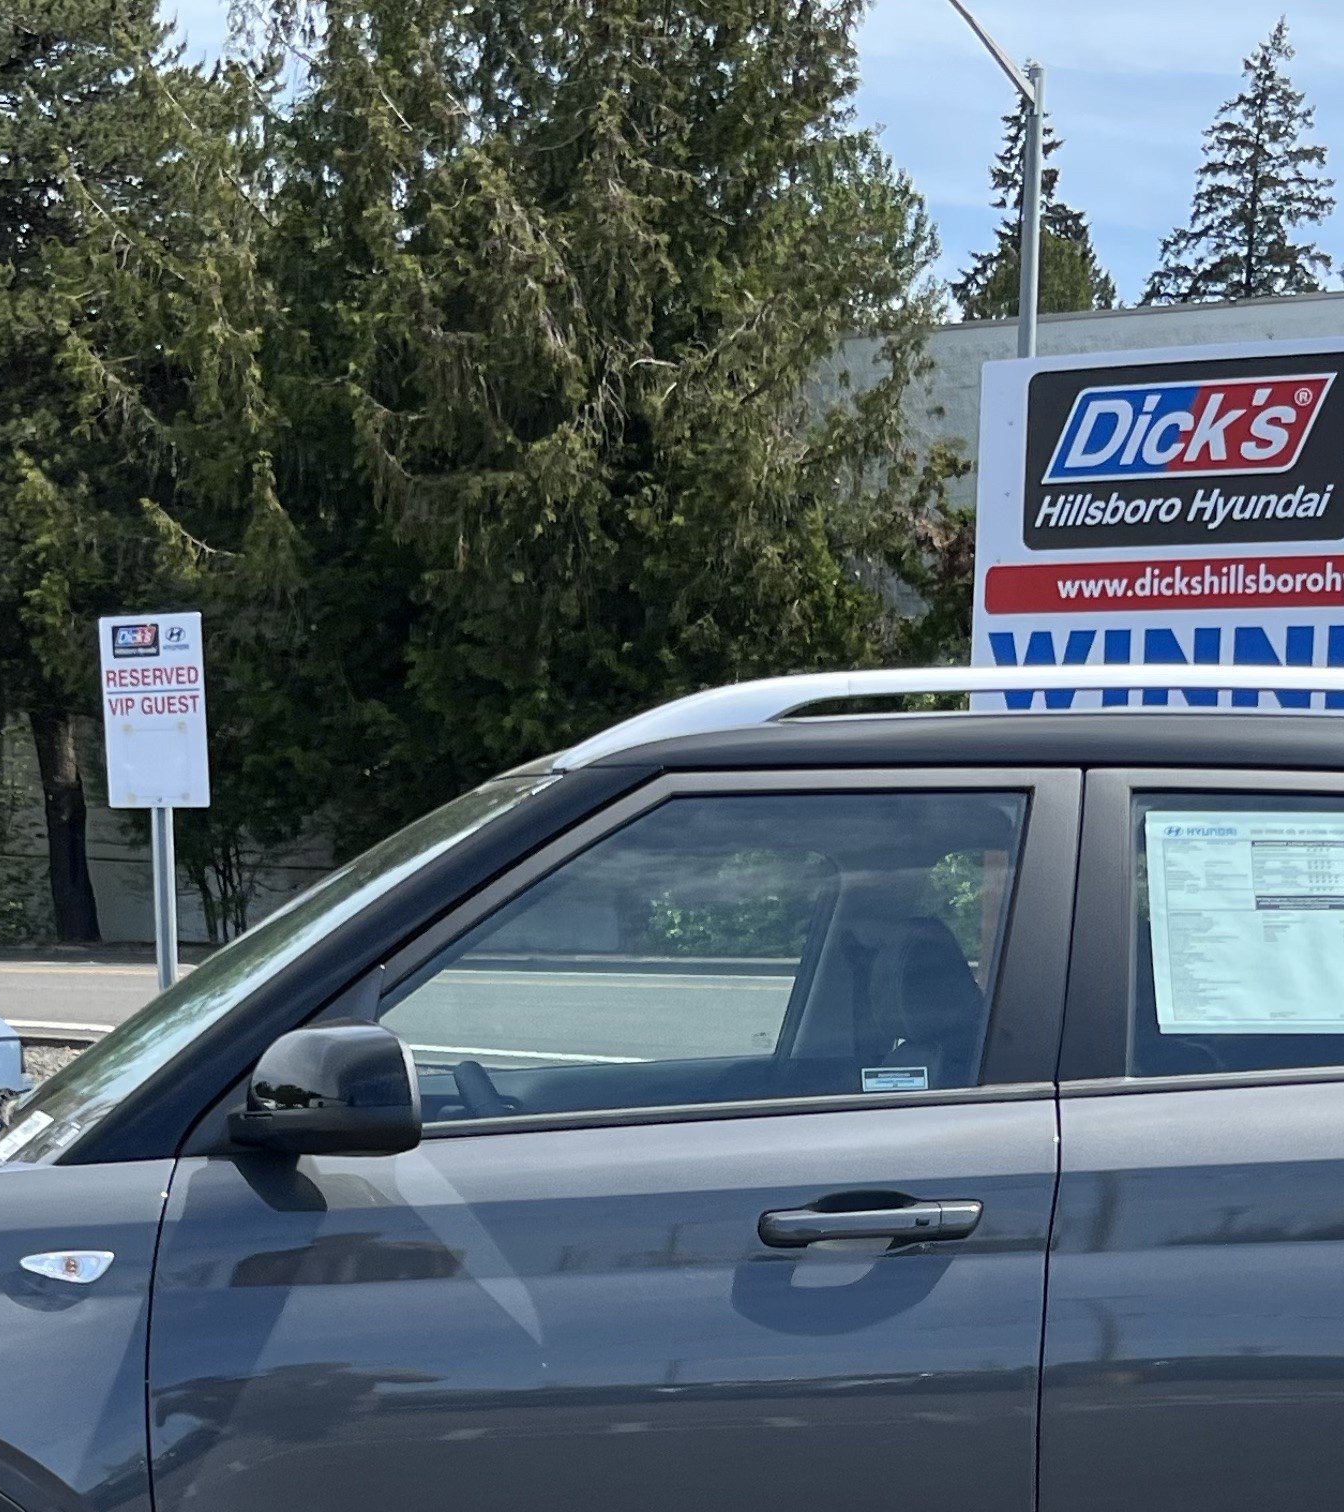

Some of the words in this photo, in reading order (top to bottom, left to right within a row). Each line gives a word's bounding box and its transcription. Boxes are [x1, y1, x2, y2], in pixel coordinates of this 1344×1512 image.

[1034, 492, 1182, 528] Hillsboro
[1186, 484, 1335, 530] Hyundai
[105, 666, 199, 688] RESERVED
[108, 698, 135, 716] VIP
[141, 694, 199, 715] GUEST
[1186, 827, 1237, 837] HYUNDAI
